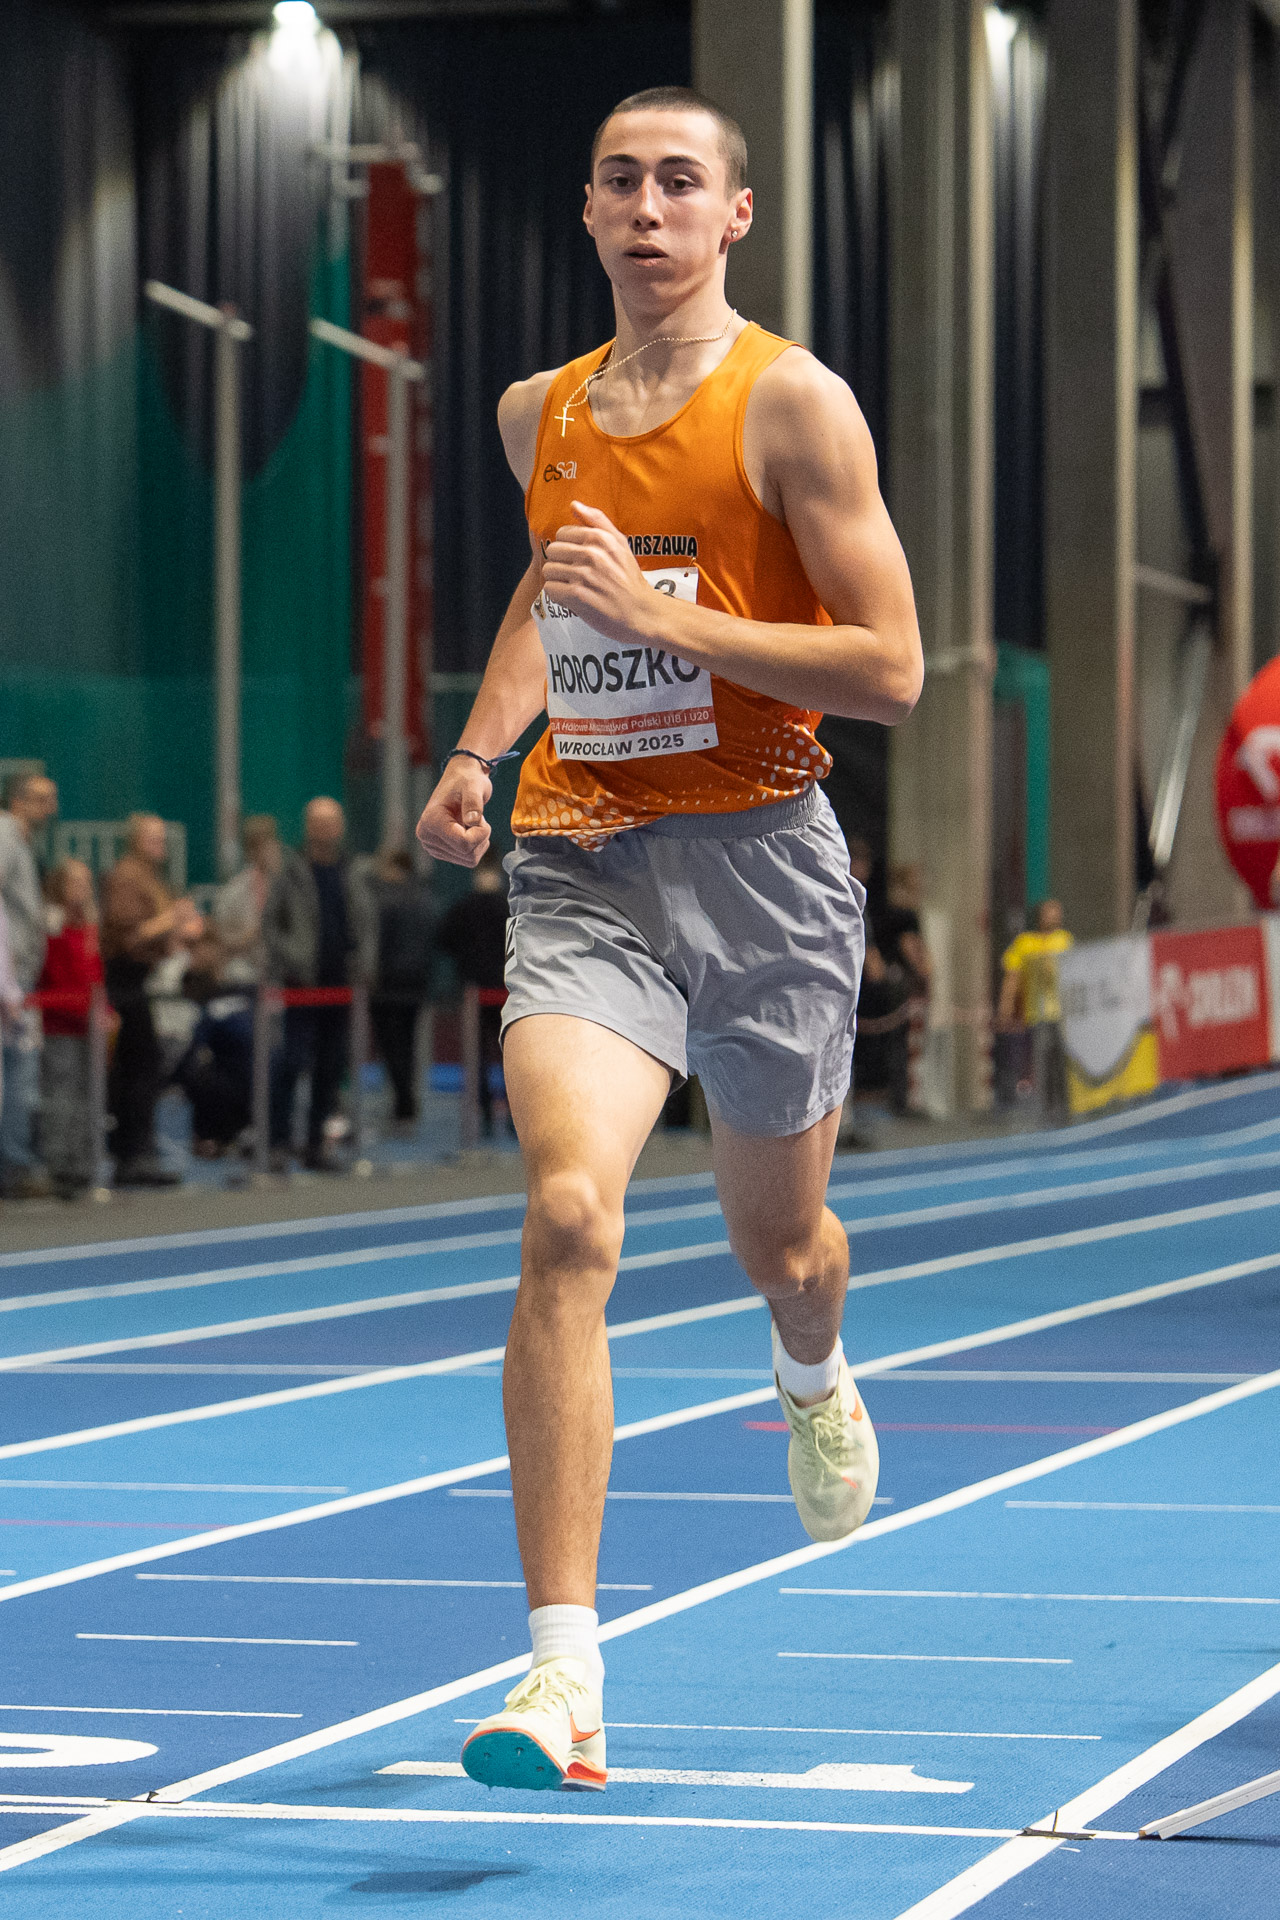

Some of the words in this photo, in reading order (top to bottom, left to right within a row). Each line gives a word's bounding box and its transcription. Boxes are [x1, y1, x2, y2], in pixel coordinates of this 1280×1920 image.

[627, 535, 698, 556] ARSZAWA
[631, 716, 661, 729] Polski
[664, 714, 681, 725] U18
[690, 710, 709, 722] U20
[560, 740, 633, 756] WROCŁAW
[637, 733, 684, 751] 2025
